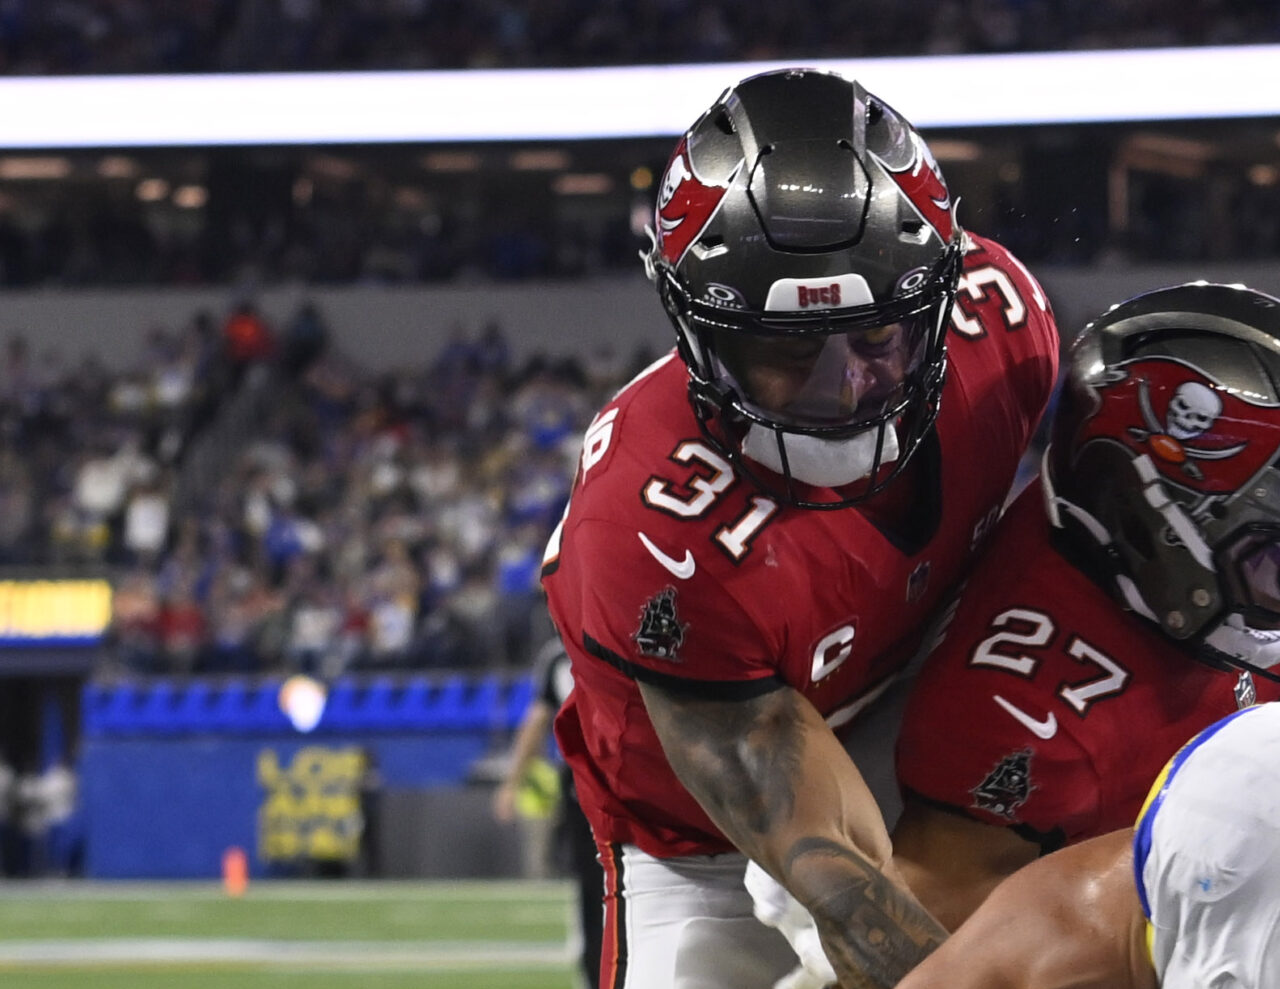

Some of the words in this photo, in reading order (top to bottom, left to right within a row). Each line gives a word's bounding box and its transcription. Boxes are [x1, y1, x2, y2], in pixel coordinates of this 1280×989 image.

[797, 283, 842, 307] BUCS
[641, 438, 780, 565] 31
[810, 625, 855, 682] C
[970, 607, 1131, 715] 27
